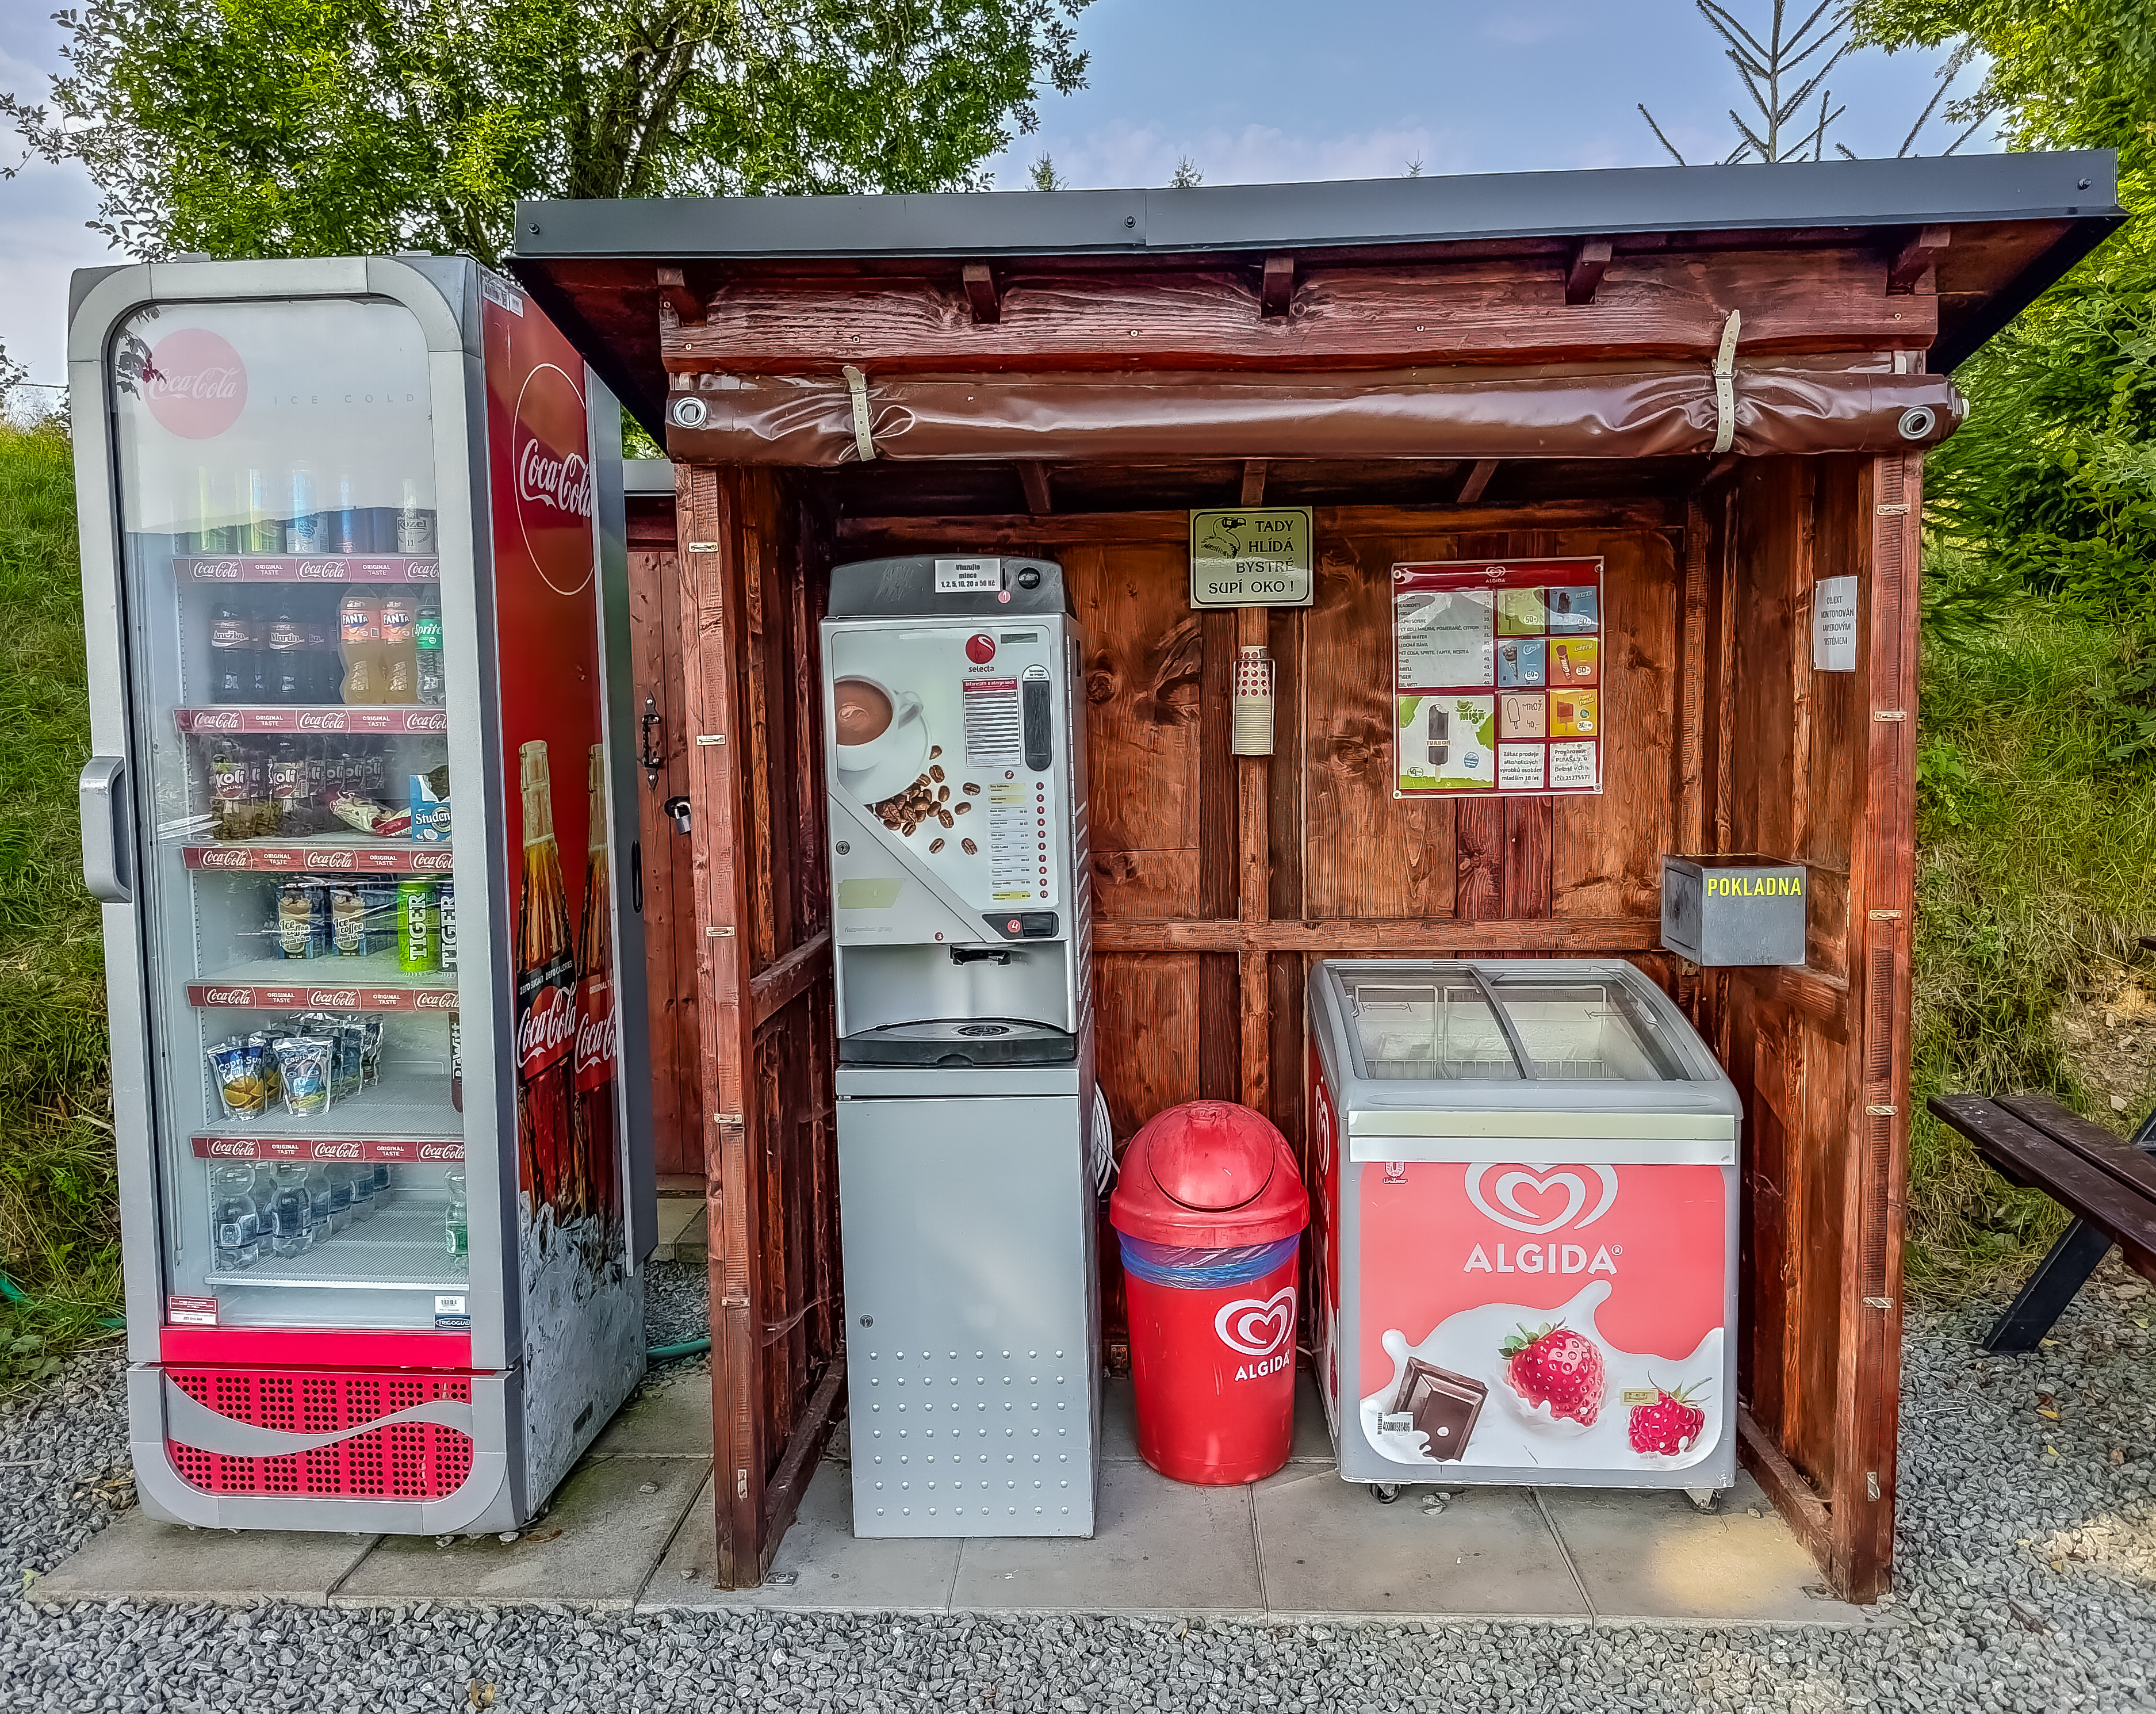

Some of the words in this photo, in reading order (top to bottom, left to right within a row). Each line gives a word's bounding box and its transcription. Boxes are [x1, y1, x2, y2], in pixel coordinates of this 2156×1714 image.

[148, 367, 241, 400] Coca-Cola
[274, 396, 318, 405] ICE
[344, 394, 414, 404] COLD
[519, 438, 591, 518] Coca-Cola
[397, 519, 428, 530] Kozel
[1255, 520, 1294, 533] TADY
[1249, 537, 1294, 553] HLÍDÁ
[193, 561, 238, 578] Coca-Cola
[299, 561, 346, 579] Coca-Cola
[1236, 557, 1294, 573] BYSTRÉ
[1208, 579, 1243, 594] SUPÍ
[1251, 580, 1285, 593] OKO
[1826, 595, 1843, 605] OBJEKT
[342, 613, 369, 625] FANTA
[383, 613, 411, 625] FANTA
[1821, 607, 1854, 619] MONITOROVÁN
[270, 632, 300, 642] Martin
[1824, 635, 1848, 646] SYSTÉMEM
[1522, 699, 1544, 711] MROŽ
[194, 712, 239, 729] Coca-Cola
[300, 712, 345, 729] Coca-Cola
[202, 850, 250, 867] Coca-Cola
[307, 851, 355, 868] Coca-Cola
[1707, 877, 1802, 897] POKLADNA
[334, 918, 349, 928] Ice
[340, 924, 363, 934] coffee
[408, 893, 427, 961] TIGER
[1011, 922, 1018, 930] 4
[441, 896, 457, 968] TIGER
[520, 982, 530, 996] zero
[530, 975, 543, 990] SUGAR
[545, 968, 556, 981] zero
[206, 989, 253, 1005] Coca-Cola
[311, 990, 358, 1006] Coca-Cola
[517, 982, 576, 1068] Coca-Cola
[219, 1056, 262, 1072] Capri-Sun
[210, 1140, 258, 1156] Coca-Cola
[315, 1142, 362, 1158] Coca-Cola
[1463, 1242, 1618, 1275] ALGIDA
[1234, 1351, 1290, 1382] ALGIDA
